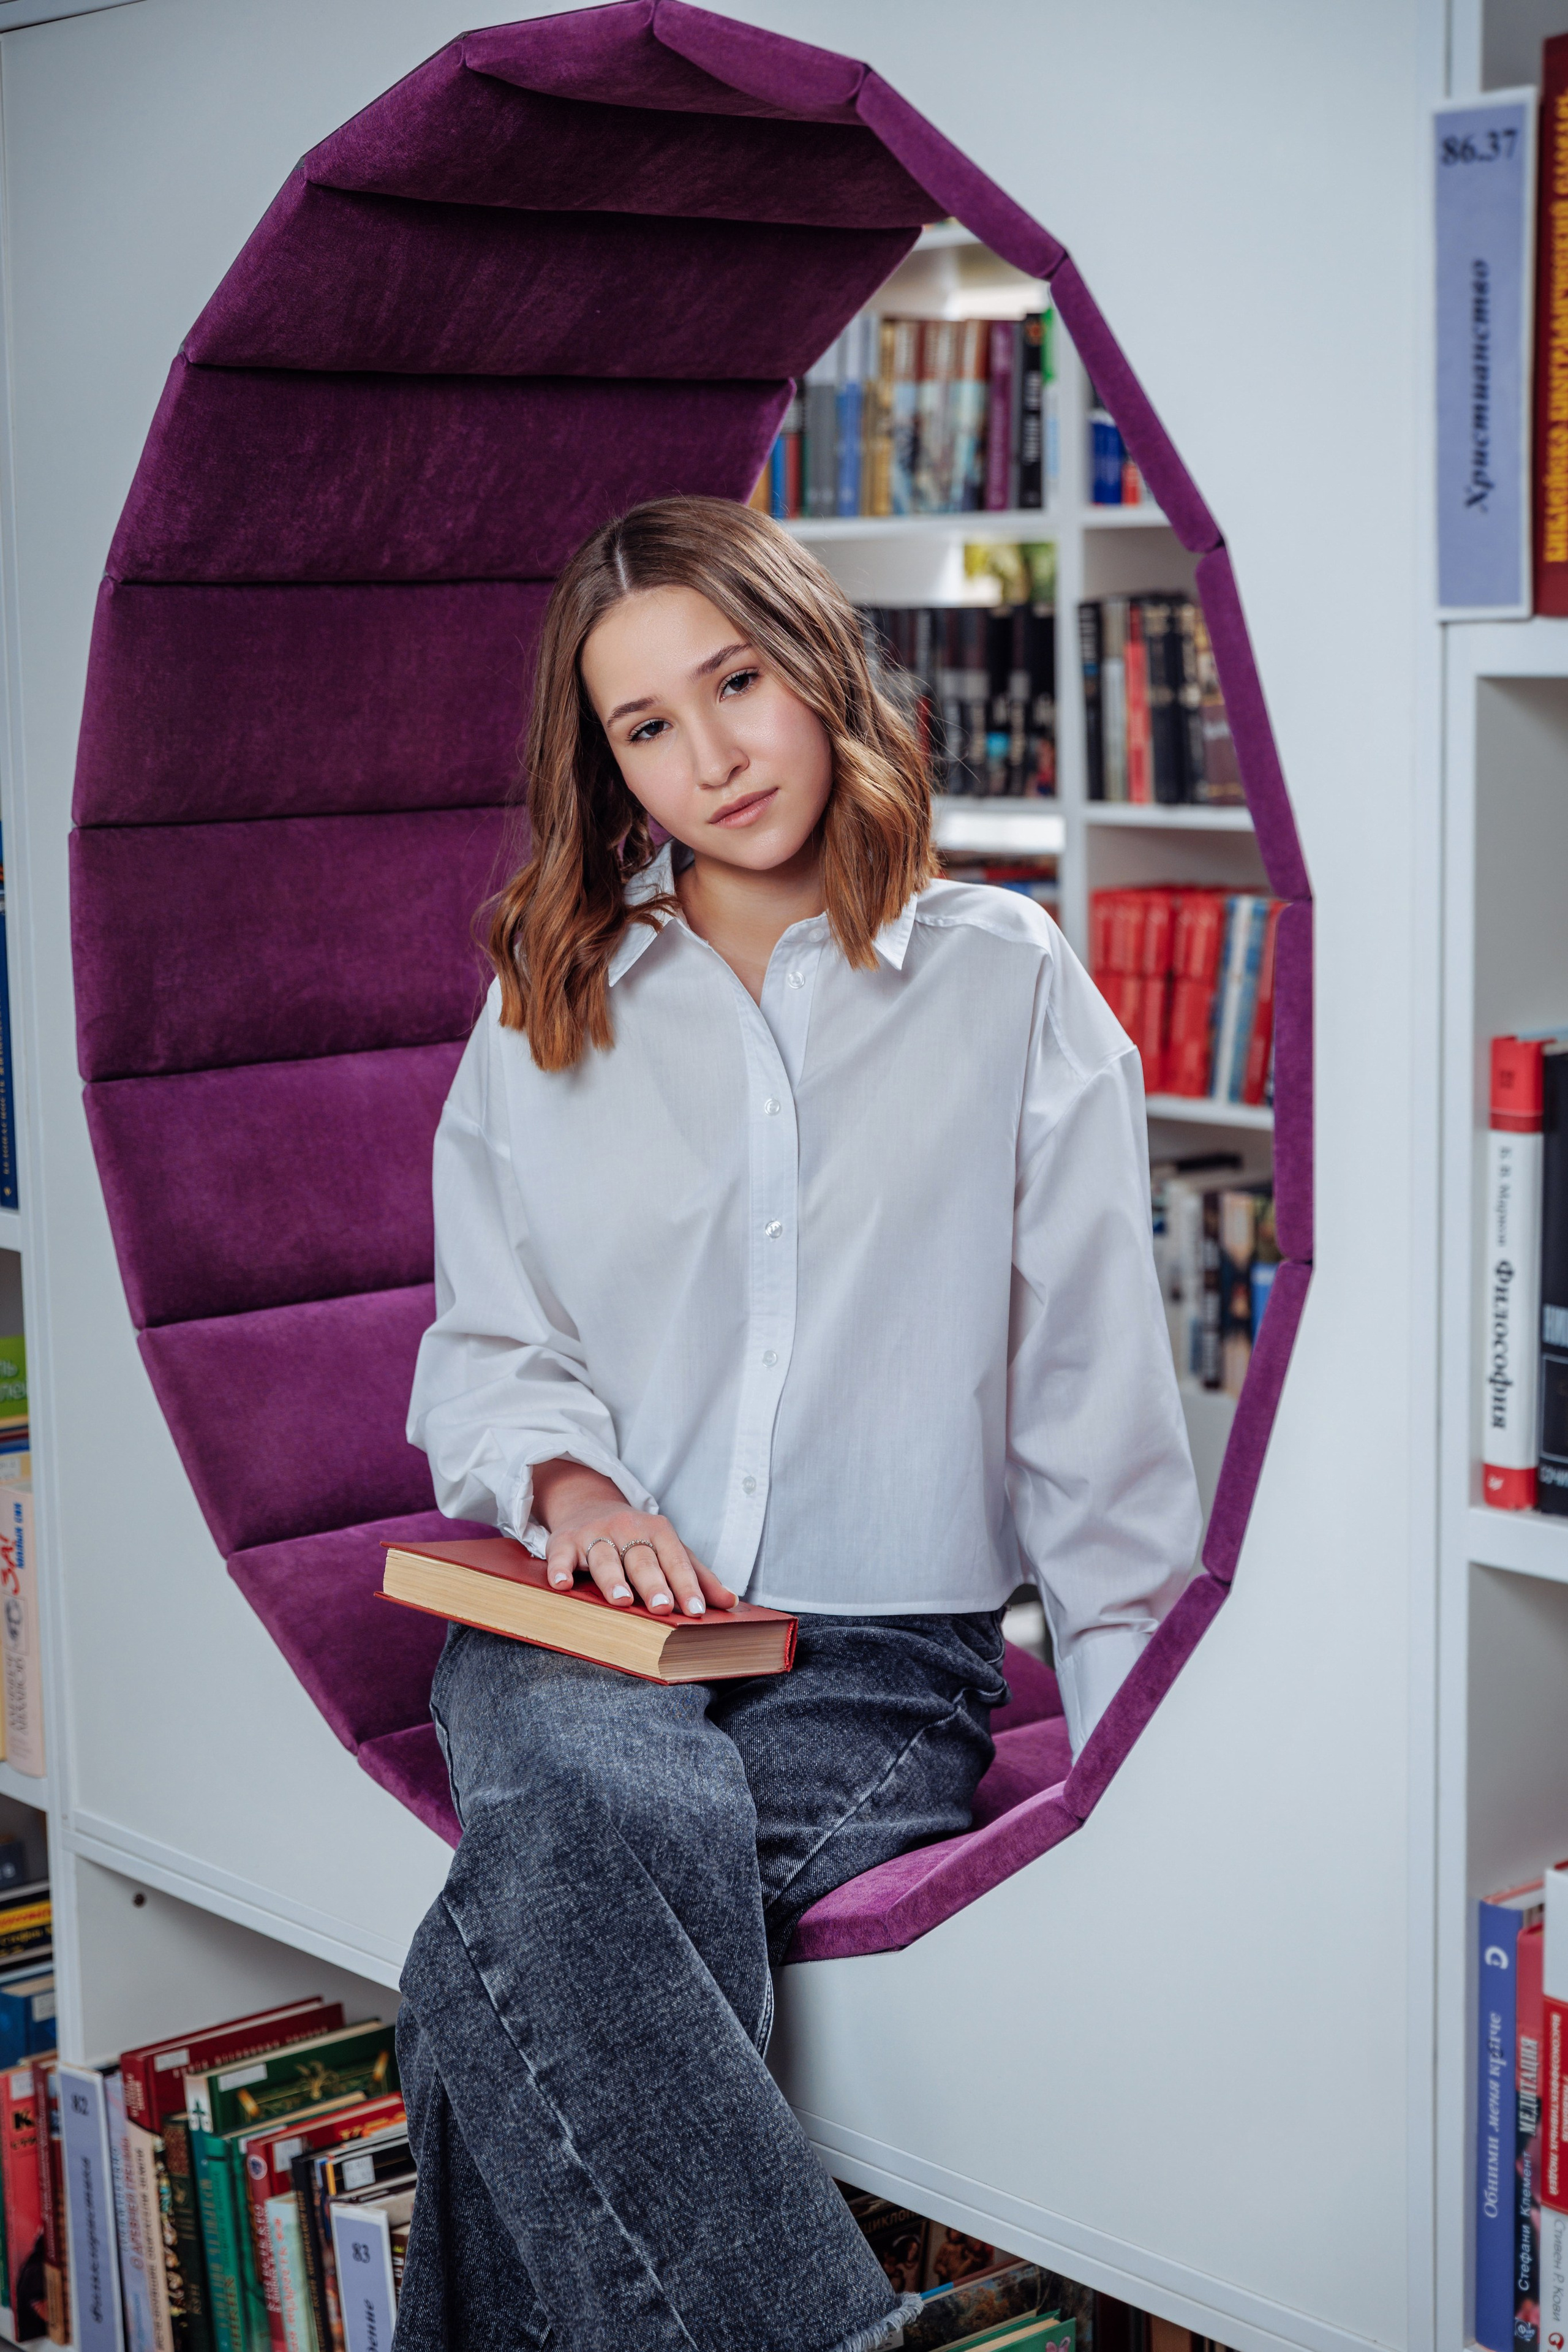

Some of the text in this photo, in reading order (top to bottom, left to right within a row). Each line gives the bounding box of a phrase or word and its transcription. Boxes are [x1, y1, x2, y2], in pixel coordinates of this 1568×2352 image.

[1441, 128, 1518, 167] 86.37
[1464, 258, 1495, 514] Христианство
[1487, 1259, 1515, 1431] Философия
[72, 2094, 88, 2116] 82
[1488, 2079, 1501, 2133] меня
[1518, 2036, 1540, 2136] МЕДИТАЦИЯ
[1548, 2012, 1561, 2196] ВЫСОКОЭФФЕКТИВНЫХ ЛЮДЕЙ
[1483, 2135, 1499, 2219] Обними
[352, 2241, 371, 2264] 83
[1518, 2152, 1533, 2291] Стефани Клемент
[1552, 2218, 1566, 2269] Стивен
[1551, 2286, 1566, 2322] Кови
